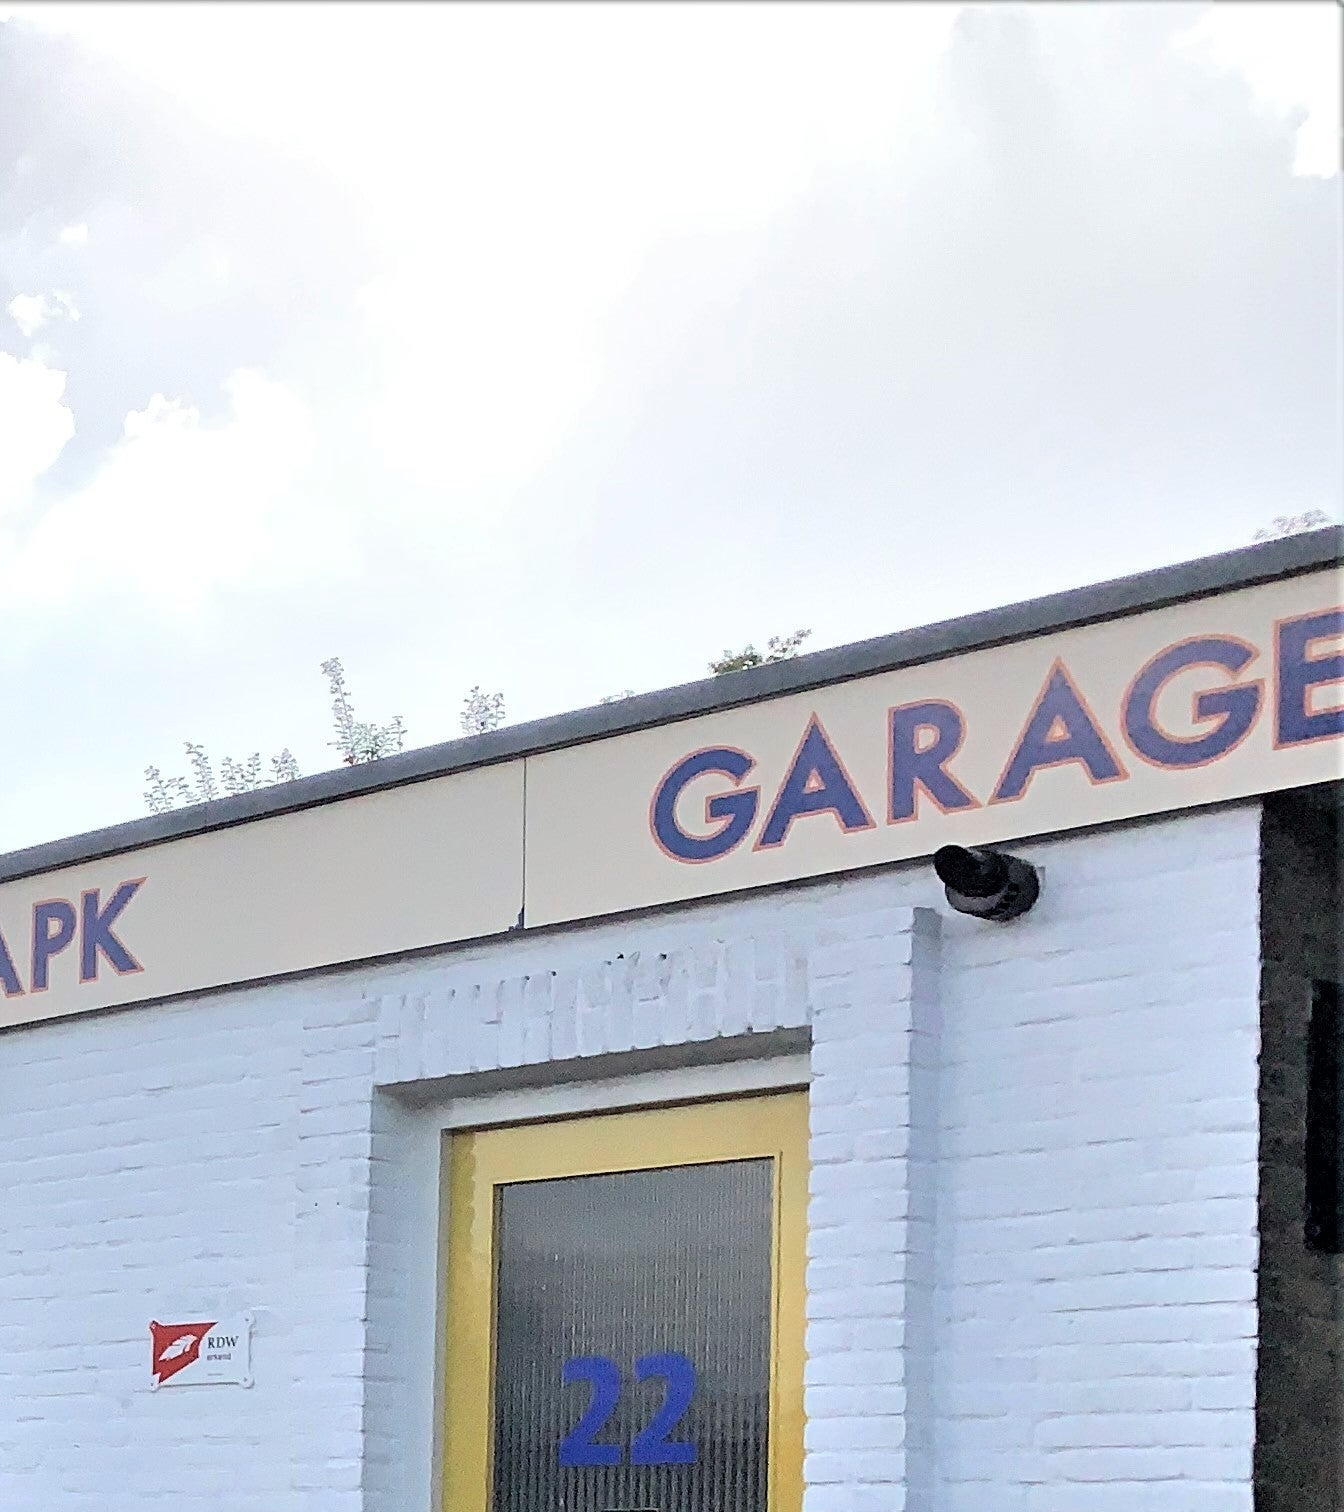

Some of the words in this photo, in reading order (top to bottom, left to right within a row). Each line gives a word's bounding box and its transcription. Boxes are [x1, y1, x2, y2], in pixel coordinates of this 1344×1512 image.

[649, 606, 1344, 864] GARAGE
[207, 1335, 239, 1349] RDW
[559, 1352, 697, 1466] 22
